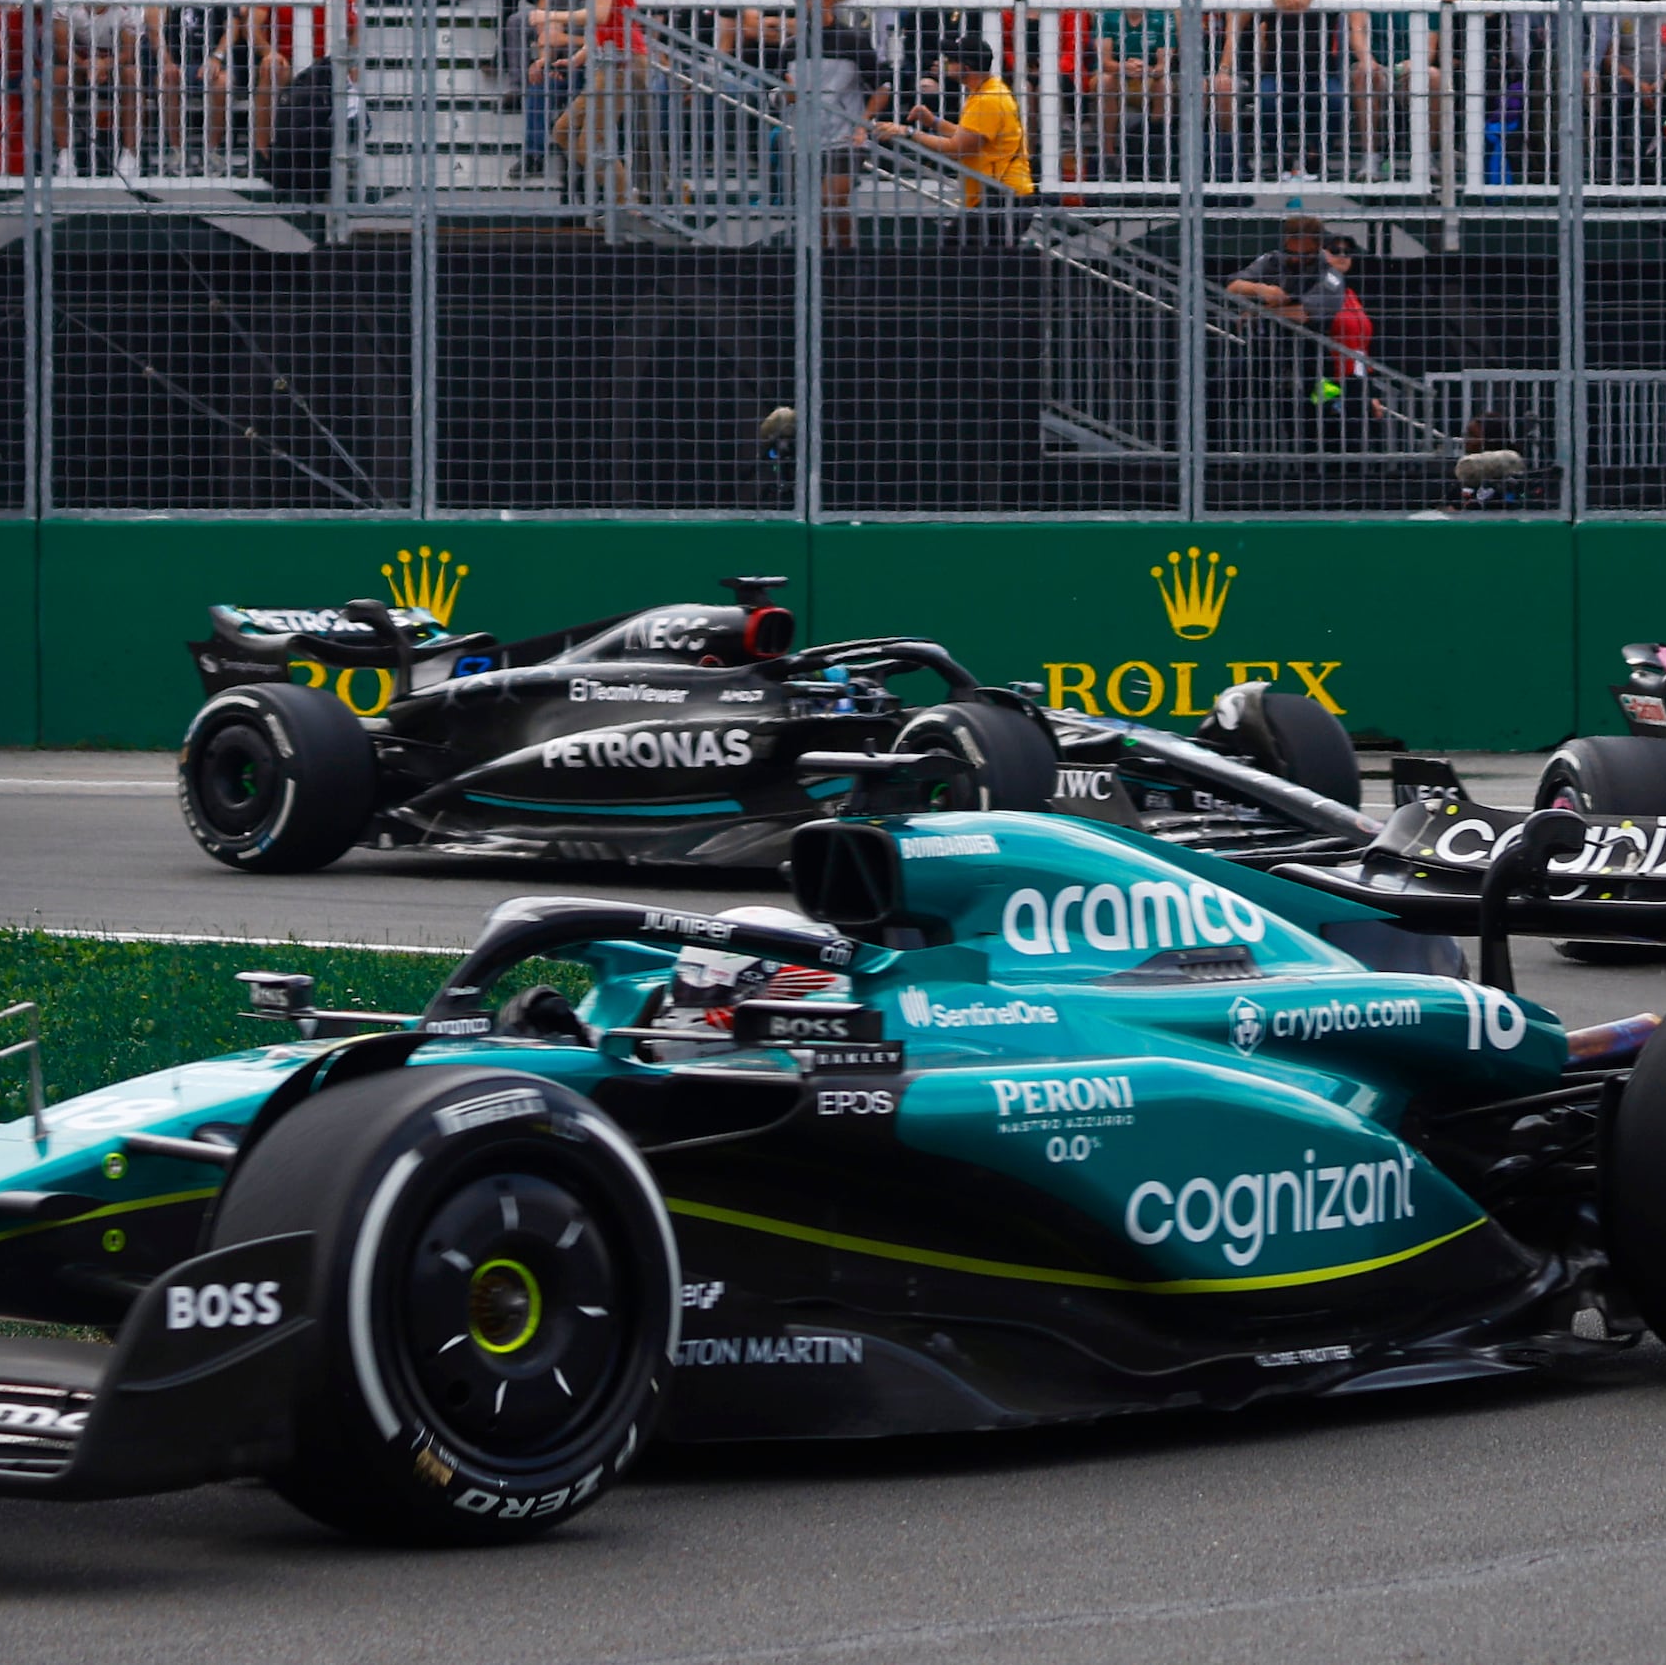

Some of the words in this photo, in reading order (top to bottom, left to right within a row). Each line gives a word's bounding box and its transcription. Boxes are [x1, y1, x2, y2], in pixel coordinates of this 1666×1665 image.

[587, 680, 690, 703] TeamViewer
[542, 728, 753, 769] PETRONAS
[1054, 769, 1112, 801] IWC
[1002, 880, 1266, 956] aramco
[769, 1016, 849, 1038] BOSS
[932, 999, 1059, 1028] SentinelOne
[1272, 997, 1423, 1041] crypto.com
[816, 1090, 895, 1116] EPOS
[990, 1075, 1135, 1116] PERONI
[997, 1118, 1061, 1134] NASTRO
[1064, 1114, 1135, 1129] AZZURRO
[1124, 1143, 1415, 1267] cognizant
[166, 1281, 282, 1330] BOSS
[745, 1336, 864, 1365] MARTIN
[452, 1463, 605, 1519] ZERO
